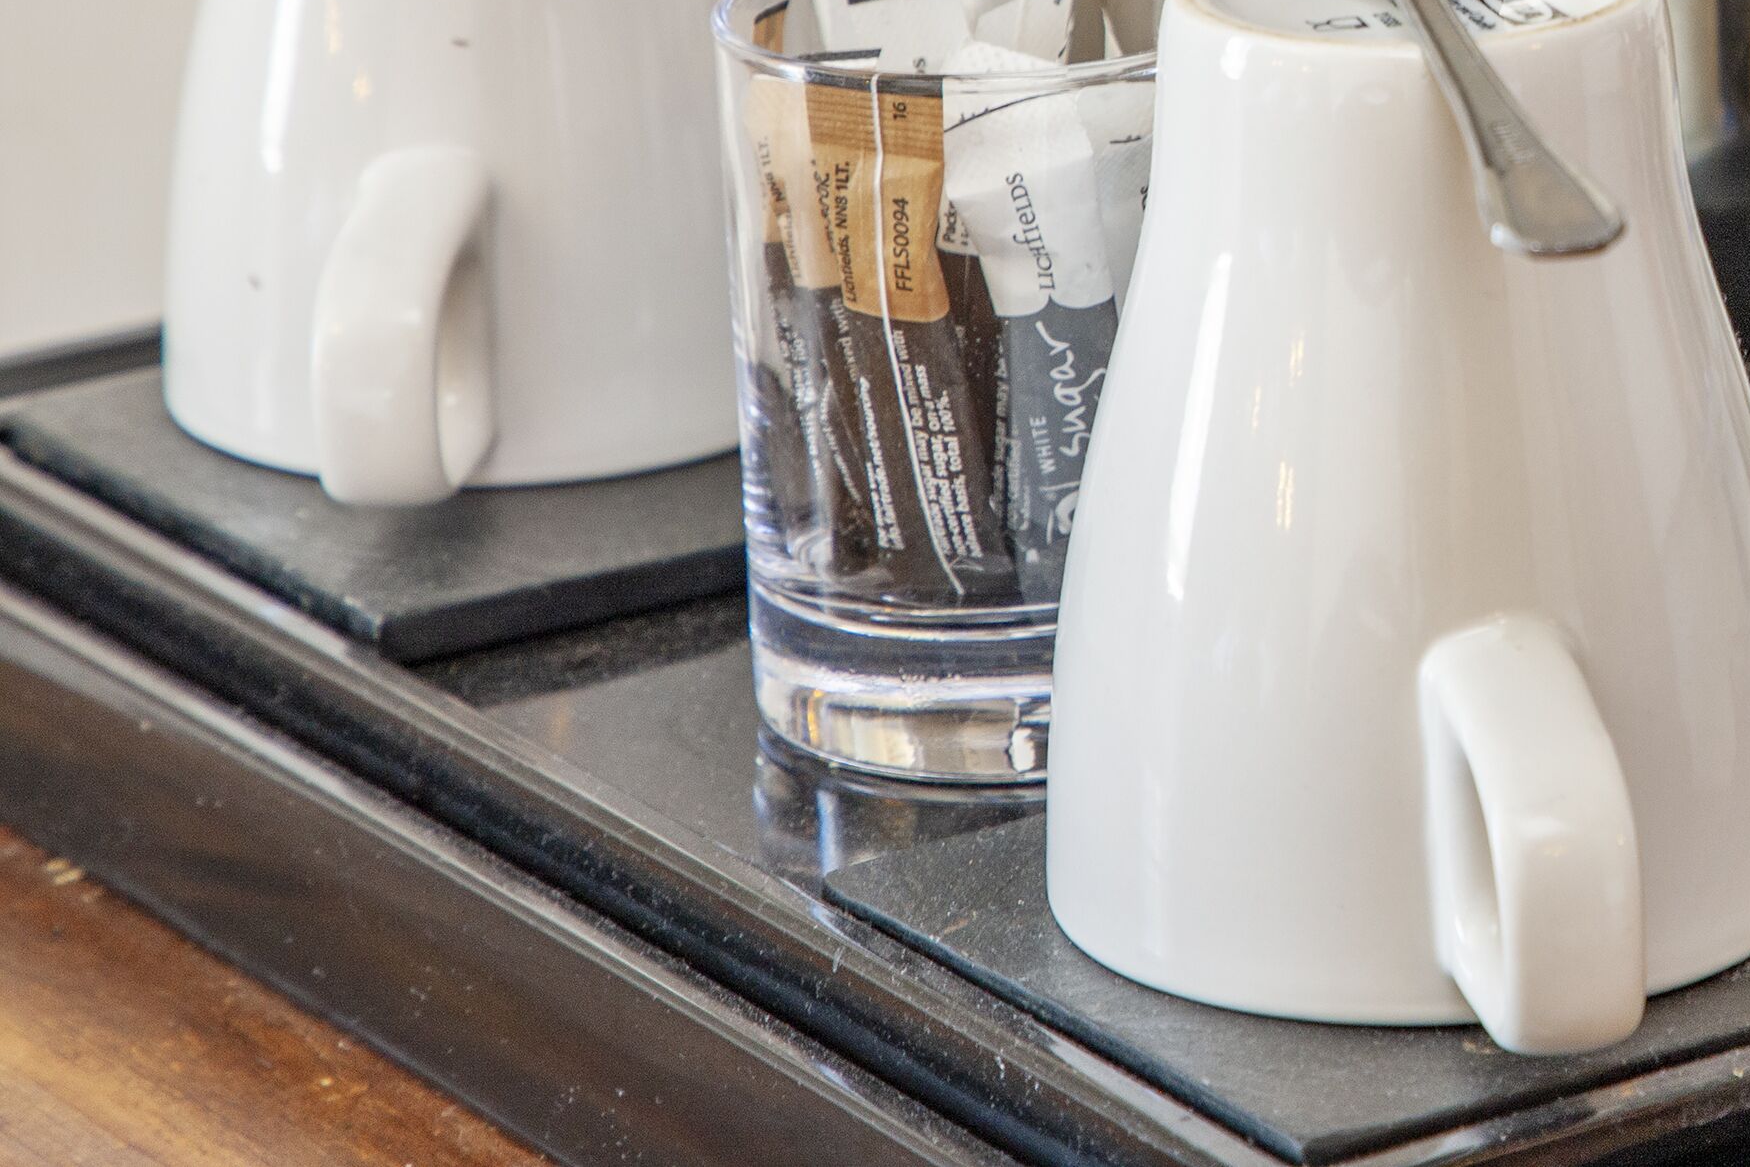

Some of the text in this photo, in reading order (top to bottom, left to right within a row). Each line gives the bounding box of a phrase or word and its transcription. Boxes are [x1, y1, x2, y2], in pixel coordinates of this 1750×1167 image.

[893, 102, 908, 121] 16
[835, 162, 850, 189] 1LT.
[835, 192, 849, 230] NN8
[893, 197, 909, 293] FFLS0094
[892, 330, 910, 361] with
[900, 363, 920, 406] mixed
[915, 364, 932, 399] mass
[1035, 320, 1107, 458] sugar
[910, 407, 924, 427] be
[927, 411, 940, 432] on
[914, 430, 930, 462] may
[943, 436, 962, 472] total
[1029, 415, 1056, 474] WHITE
[919, 463, 938, 502] sugar
